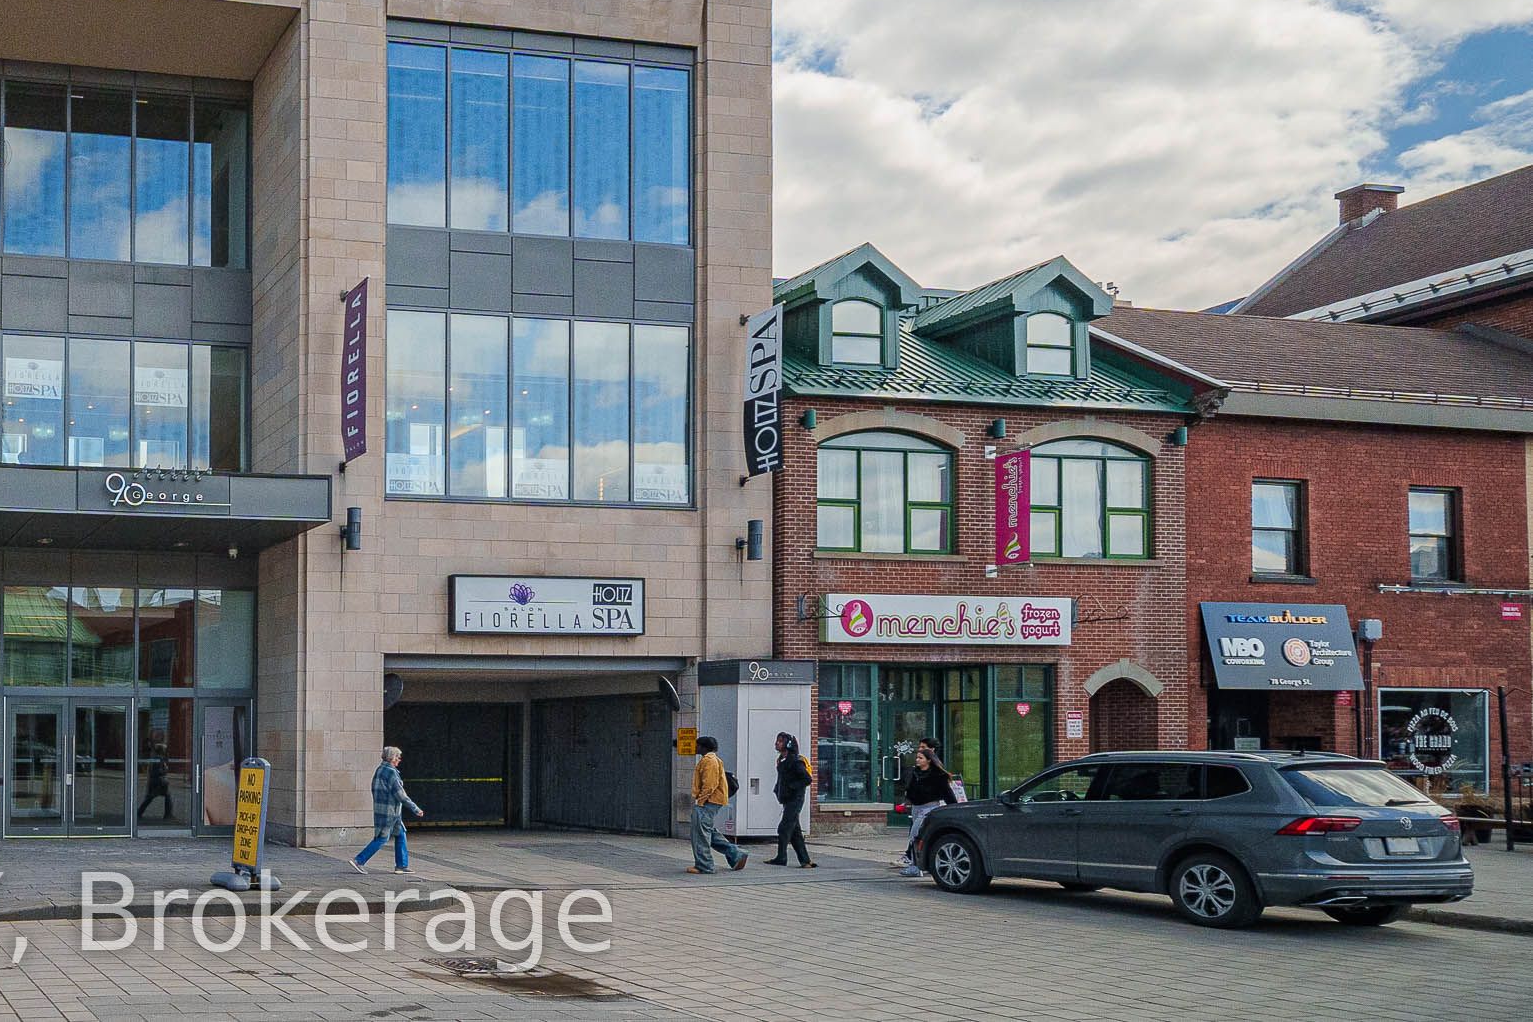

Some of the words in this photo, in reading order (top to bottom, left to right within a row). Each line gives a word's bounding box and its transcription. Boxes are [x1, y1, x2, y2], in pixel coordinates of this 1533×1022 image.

[749, 313, 778, 396] SPA
[346, 291, 362, 438] FIORELLA
[33, 384, 58, 397] SPA
[159, 392, 184, 405] SPA
[754, 388, 779, 472] HOLTZ
[106, 473, 146, 507] 90
[133, 491, 204, 503] George
[539, 484, 564, 498] SPA
[1001, 456, 1018, 528] menchie's
[593, 584, 633, 604] HOLTZ
[464, 611, 582, 630] FIORELLA
[592, 607, 636, 631] SPA
[876, 600, 1018, 640] menchie's
[1022, 603, 1060, 623] frozen
[1022, 623, 1060, 639] yogurt
[1220, 637, 1266, 658] MBO
[1308, 639, 1330, 649] Taylor
[1311, 648, 1353, 656] Architecture
[1312, 657, 1335, 666] Group
[1279, 678, 1302, 687] George
[1407, 714, 1421, 732] PIZZA
[1441, 753, 1458, 771] PIZZA
[247, 773, 256, 786] NO
[239, 789, 261, 805] PARKING
[239, 811, 256, 823] PICK-UP
[236, 823, 258, 836] DROP-OFF
[240, 836, 252, 848] ZONE
[239, 849, 251, 861] ONLY
